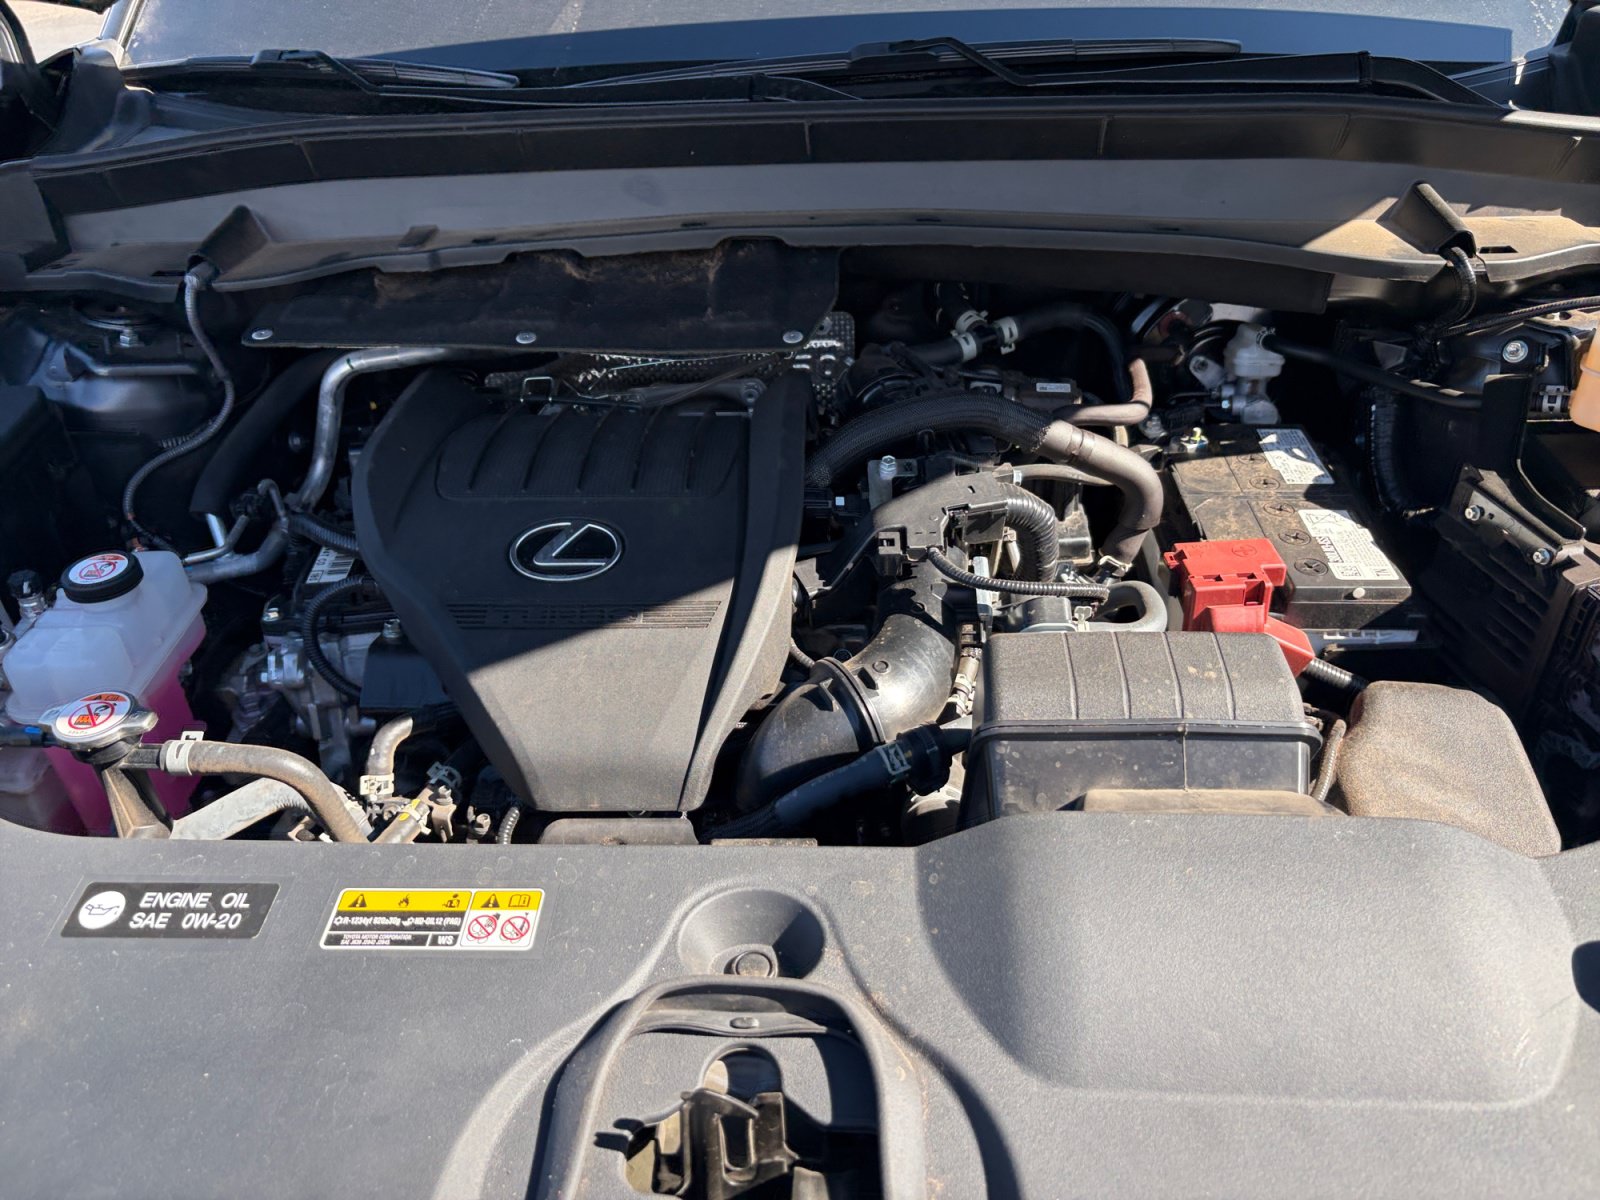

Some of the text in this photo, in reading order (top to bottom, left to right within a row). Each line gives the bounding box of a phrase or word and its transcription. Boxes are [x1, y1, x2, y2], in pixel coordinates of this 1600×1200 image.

[139, 892, 251, 909] ENGINE OIL
[129, 912, 242, 930] SAE 0W-20
[437, 935, 454, 945] WS
